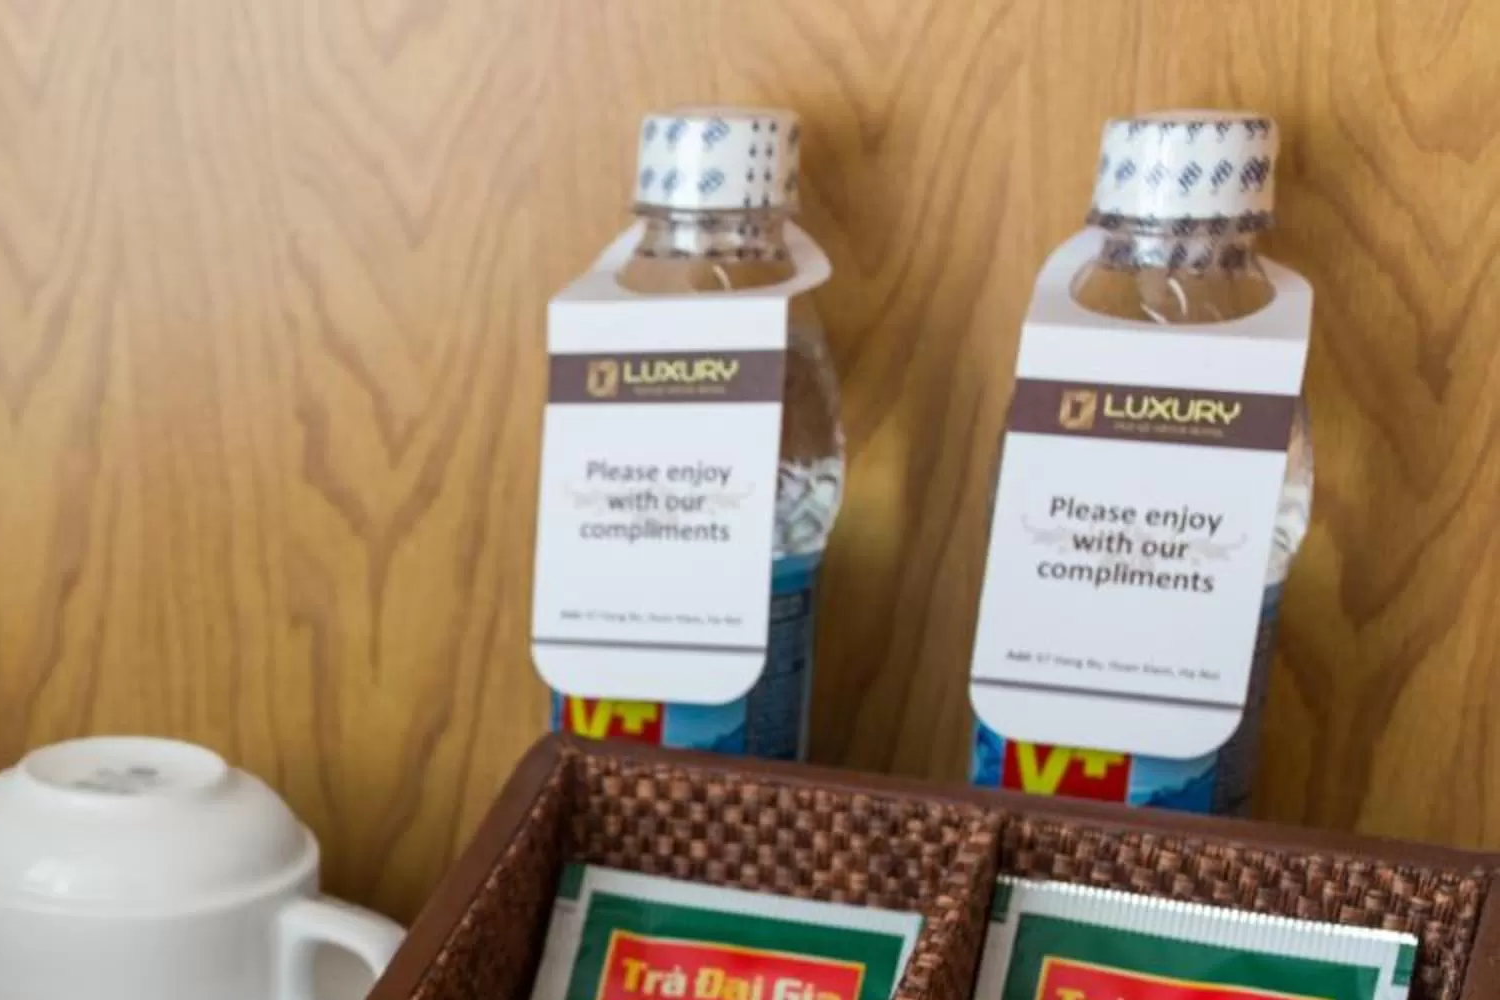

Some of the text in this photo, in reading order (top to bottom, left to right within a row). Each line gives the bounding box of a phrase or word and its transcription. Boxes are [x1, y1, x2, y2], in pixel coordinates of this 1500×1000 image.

[623, 359, 740, 384] LUXURY
[1103, 392, 1242, 425] LUXURY
[585, 460, 733, 486] Please enjoy
[605, 490, 707, 513] with our
[1049, 494, 1224, 536] Please enjoy
[579, 520, 731, 545] compliments
[1071, 530, 1191, 561] with our
[1036, 559, 1216, 594] compliments
[621, 957, 688, 997] Trà
